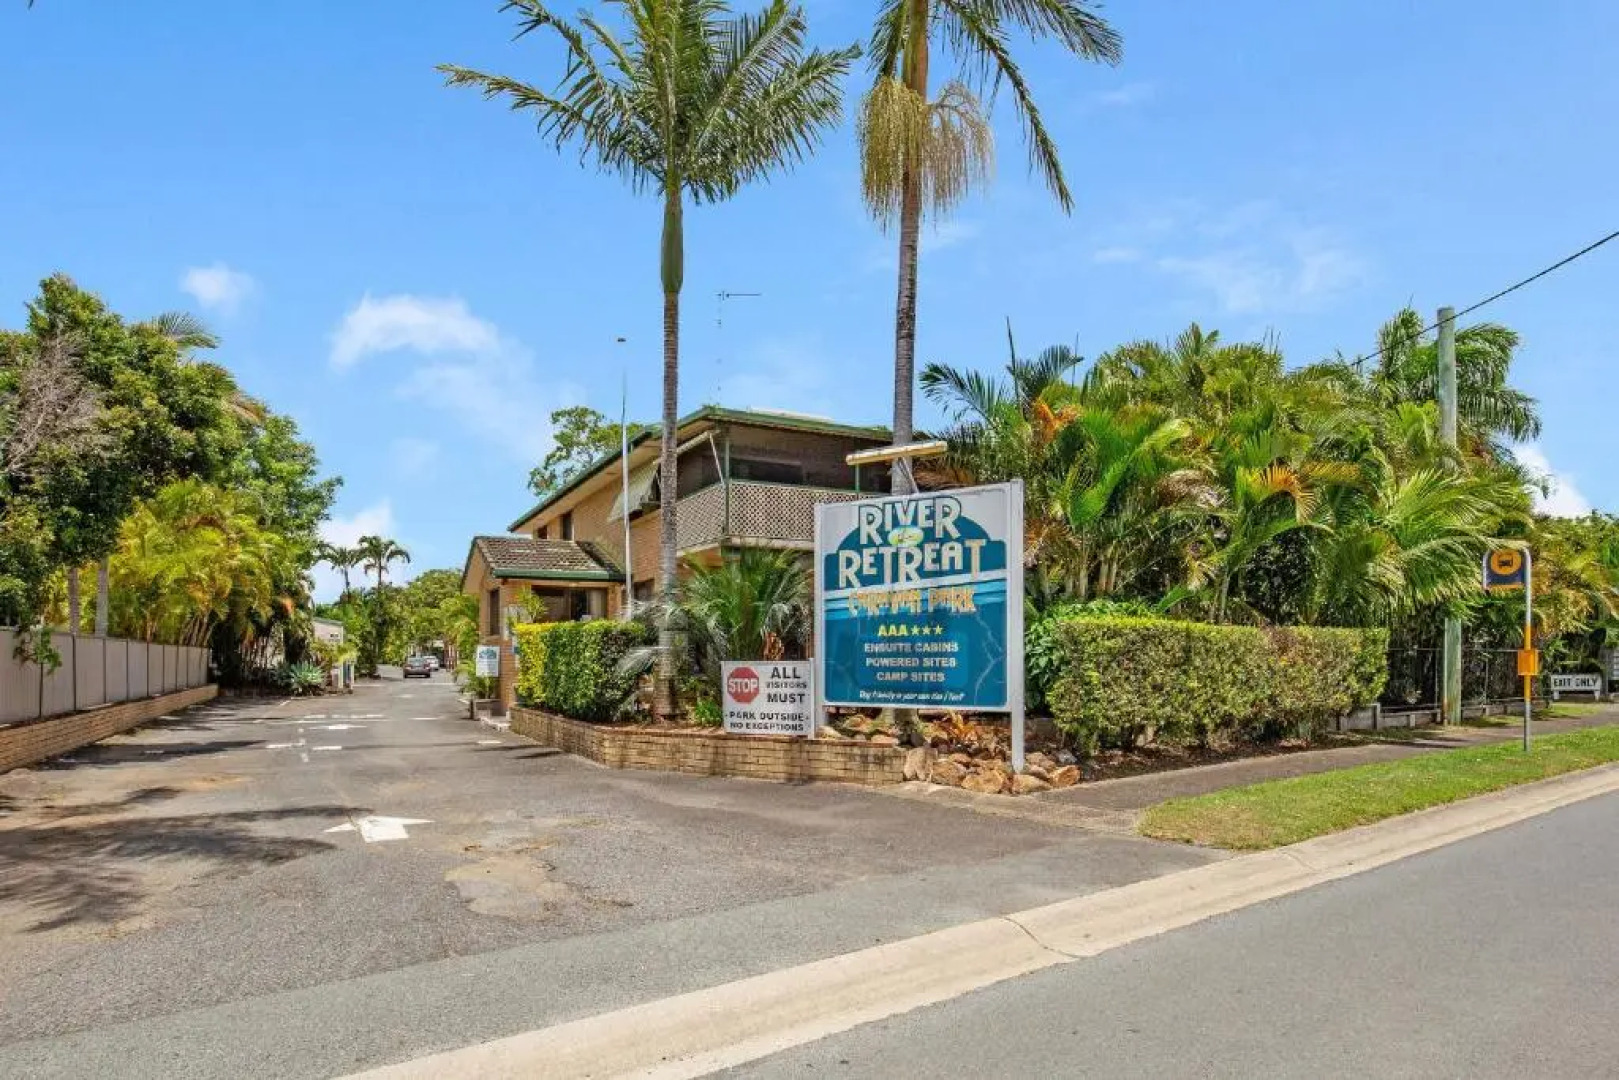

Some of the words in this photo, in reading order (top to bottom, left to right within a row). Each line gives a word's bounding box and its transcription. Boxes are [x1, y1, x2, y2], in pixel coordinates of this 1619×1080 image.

[859, 496, 962, 545] RIVER
[839, 538, 987, 588] RETREAT
[914, 641, 959, 652] CABINS
[865, 657, 919, 668] POWERED
[922, 657, 956, 668] SITES
[770, 666, 801, 679] ALL
[876, 671, 908, 681] CAMP
[910, 671, 945, 682] SITES
[728, 679, 758, 693] STOP
[765, 681, 807, 689] VISITORS
[766, 693, 805, 703] MUST
[729, 711, 755, 720] PARK
[760, 712, 804, 722] OUTSIDE
[729, 722, 743, 730] NO
[745, 722, 804, 731] EXCEPTIONS
